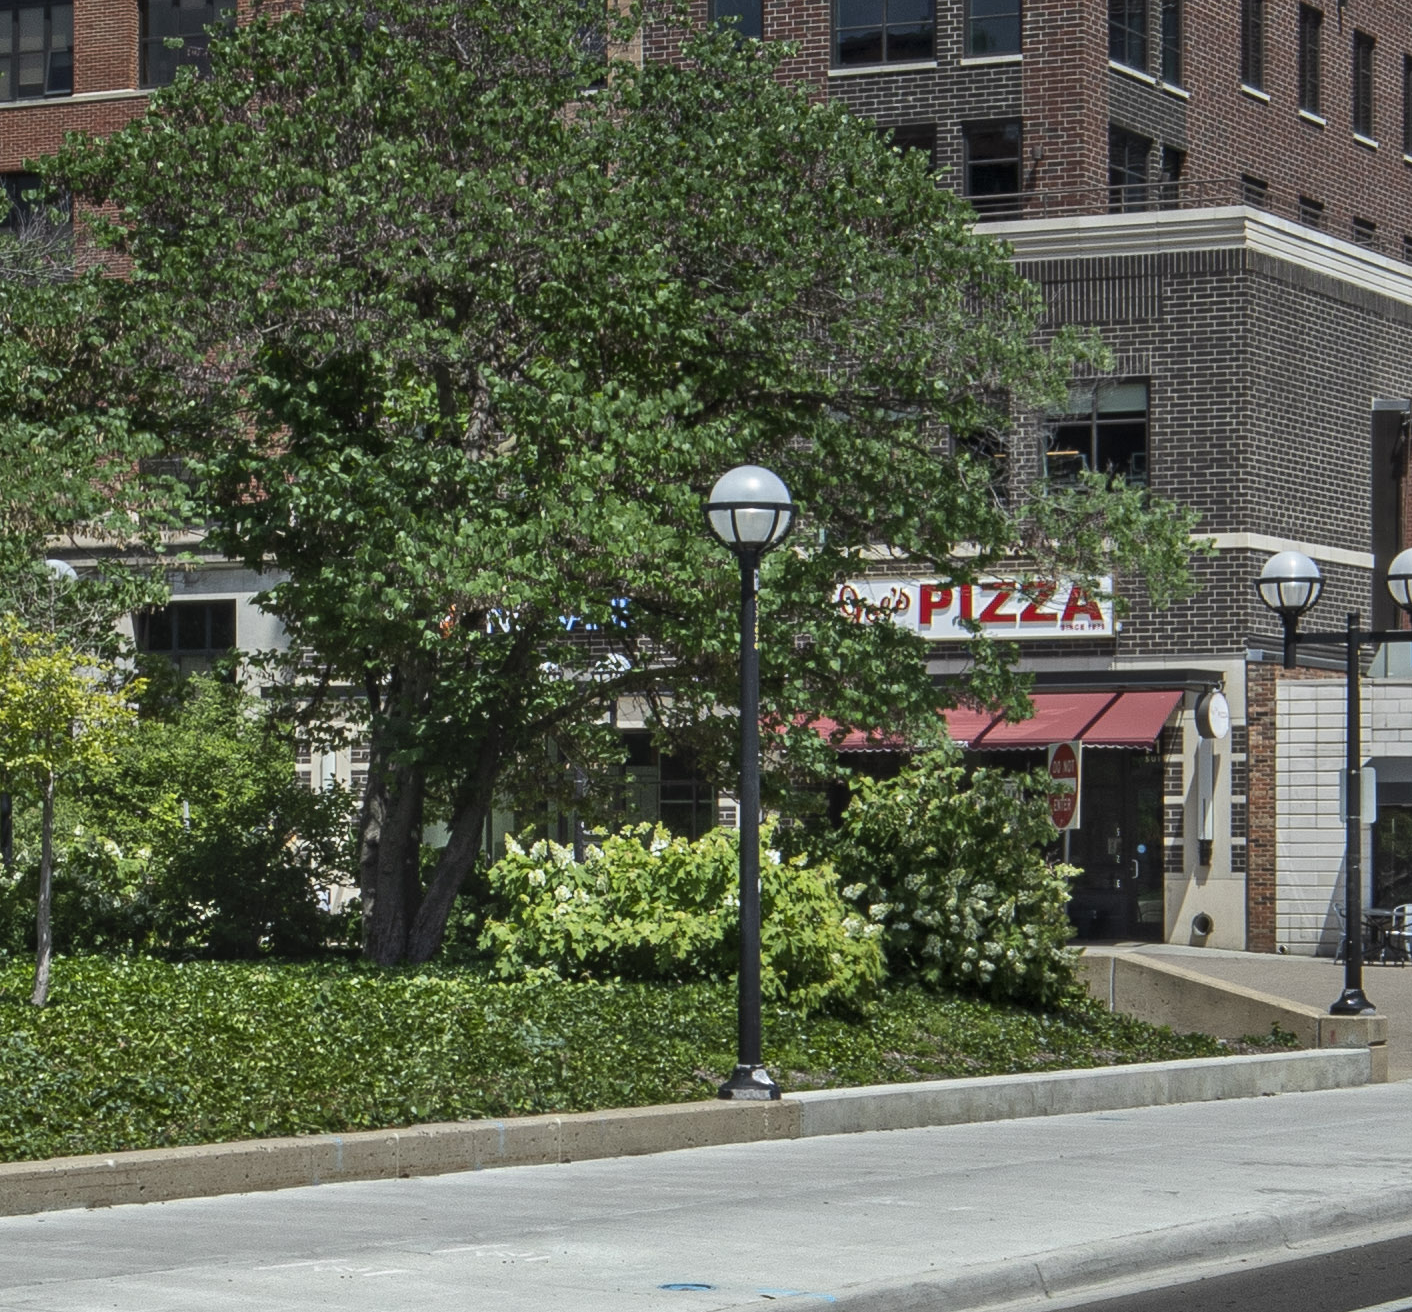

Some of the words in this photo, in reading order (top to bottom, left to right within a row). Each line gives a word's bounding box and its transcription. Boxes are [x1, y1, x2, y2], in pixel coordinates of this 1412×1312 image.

[919, 581, 1104, 625] PIZZA
[1052, 760, 1061, 773] DO
[1063, 758, 1075, 773] NOT
[1053, 798, 1072, 812] ENTER
